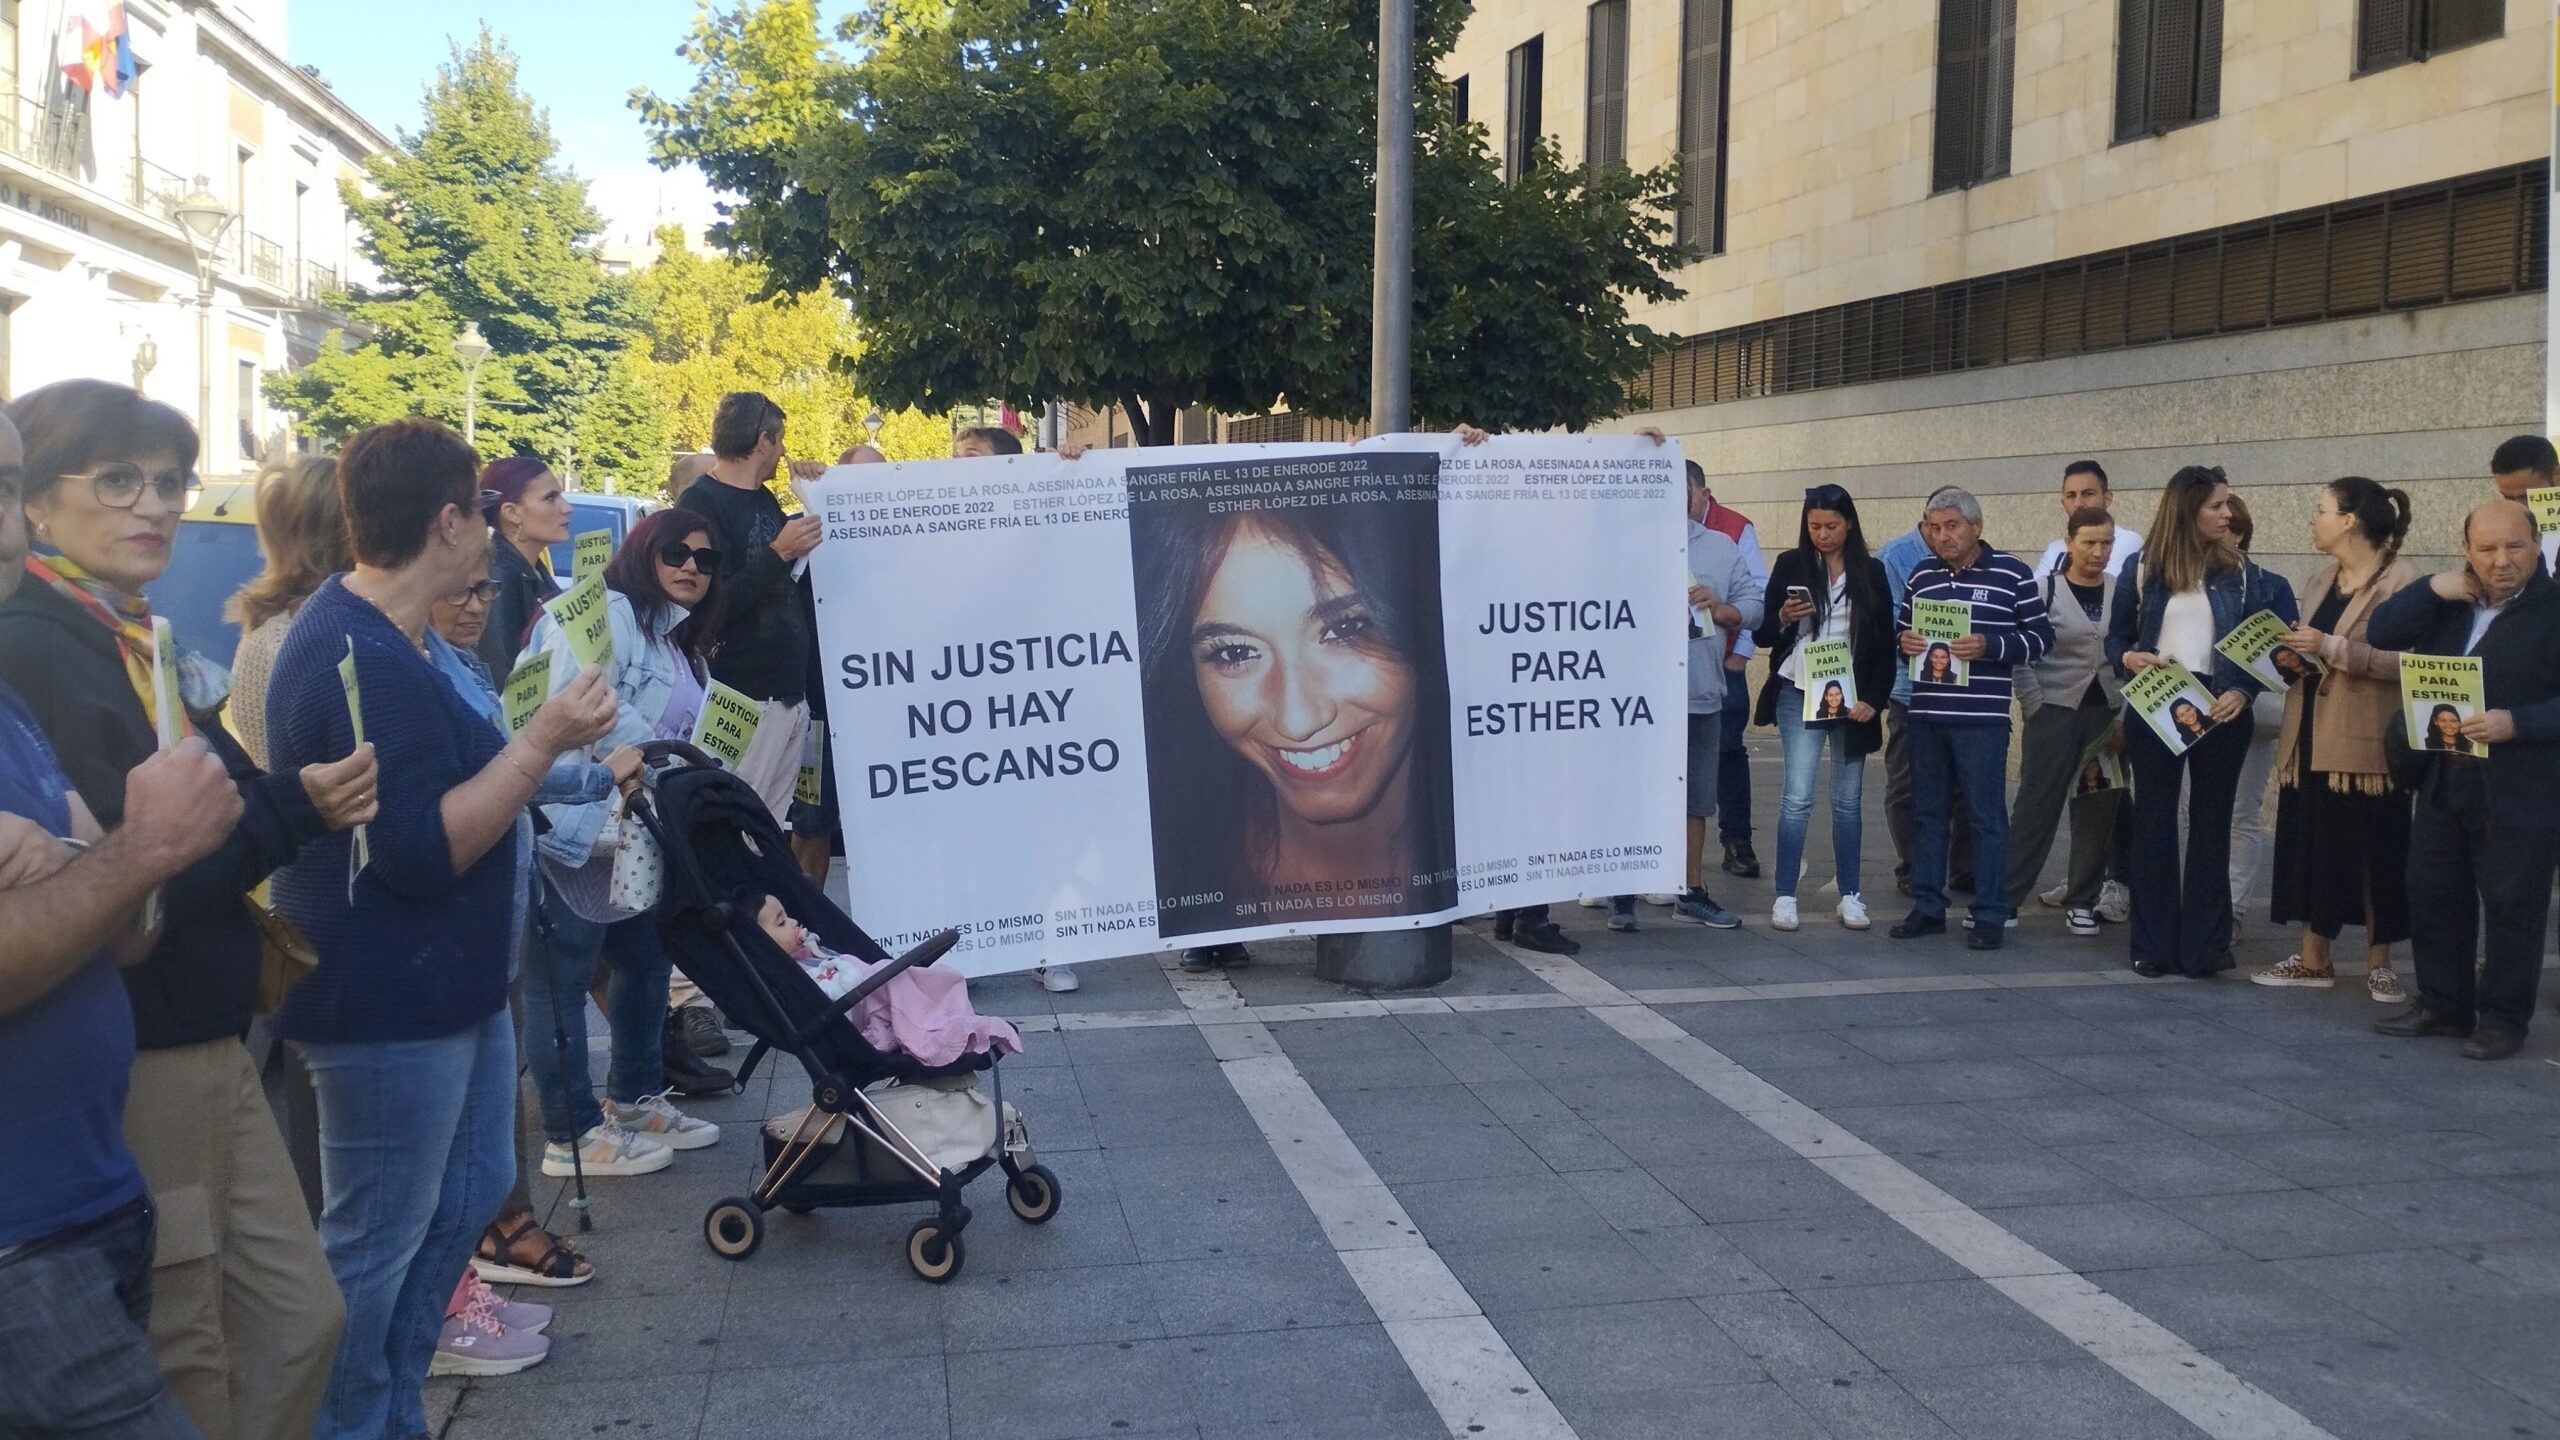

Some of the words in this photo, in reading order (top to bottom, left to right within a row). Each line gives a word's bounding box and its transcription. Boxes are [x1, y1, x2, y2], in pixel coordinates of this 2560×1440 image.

[39, 200, 88, 234] JUSTICIA
[1456, 460, 1470, 470] DE
[1475, 460, 1488, 470] LA
[1491, 460, 1526, 470] ROSA,
[1528, 460, 1590, 470] ASESINADA
[1593, 460, 1600, 469] A
[1602, 460, 1646, 470] SANGRE
[1649, 457, 1673, 470] FRÍA
[826, 492, 883, 506] ESTHER
[888, 486, 934, 502] LÓPEZ
[938, 486, 957, 499] DE
[961, 485, 977, 497] LA
[982, 483, 1024, 497] ROSA,
[1027, 478, 1104, 493] ASESINADA
[1107, 476, 1117, 487] A
[1120, 473, 1176, 487] SANGRE
[1181, 467, 1211, 482] FRÍA
[1214, 469, 1231, 481] EL
[1234, 468, 1248, 479] 13
[1252, 466, 1269, 478] DE
[1273, 462, 1337, 476] ENERODE
[1339, 460, 1368, 472] 2022
[1525, 474, 1568, 484] ESTHER
[1571, 472, 1605, 484] LÓPEZ
[1608, 474, 1623, 484] DE
[1626, 474, 1639, 484] LA
[1642, 474, 1672, 485] ROSA,
[1013, 498, 1065, 510] ESTHER
[1069, 491, 1113, 506] LÓPEZ
[1118, 492, 1136, 504] DE
[1140, 490, 1158, 502] LA
[1160, 488, 1202, 501] ROSA,
[1206, 482, 1282, 498] ASESINADA
[1284, 481, 1294, 492] A
[1296, 476, 1350, 491] SANGRE
[1354, 472, 1383, 487] FRÍA
[1385, 474, 1399, 485] EL
[1402, 474, 1415, 485] 13
[1417, 474, 1430, 485] DE
[1486, 474, 1510, 484] 2022
[1208, 500, 1261, 514] ESTHER
[1264, 495, 1307, 509] LÓPEZ
[1310, 494, 1328, 506] DE
[1332, 493, 1348, 504] LA
[1351, 490, 1390, 503] ROSA,
[1396, 490, 1454, 500] ASESINADA
[1456, 490, 1463, 500] A
[1466, 490, 1510, 500] SANGRE
[1542, 490, 1555, 500] EL
[1559, 490, 1570, 500] 13
[1573, 490, 1587, 499] DE
[1643, 488, 1666, 498] 2022
[827, 511, 846, 523] EL
[850, 510, 865, 521] 13
[870, 508, 889, 520] DE
[893, 504, 961, 518] ENERODE
[964, 502, 994, 514] 2022
[829, 524, 912, 540] ASESINADA
[916, 524, 925, 534] A
[928, 518, 986, 534] SANGRE
[990, 514, 1022, 529] FRÍA
[1025, 515, 1041, 526] EL
[1044, 514, 1058, 524] 13
[1062, 512, 1080, 523] DE
[582, 556, 607, 566] PARA
[1479, 600, 1636, 634] JUSTICIA
[1914, 602, 1969, 616] #JUSTICIA
[1924, 616, 1954, 626] PARA
[2220, 612, 2274, 652] #JUSTICIA
[1918, 628, 1960, 640] ESTHER
[2241, 626, 2272, 651] PARA
[842, 650, 915, 690] SIN
[930, 630, 1133, 681] JUSTICIA
[1804, 642, 1848, 656] #JUSTICIA
[1512, 650, 1606, 683] PARA
[1816, 656, 1840, 666] PARA
[2401, 659, 2478, 672] #JUSTICIA
[1812, 667, 1847, 679] ESTHER
[2419, 675, 2459, 687] PARA
[516, 684, 538, 706] PARA
[2144, 674, 2173, 698] PARA
[2146, 680, 2188, 714] ESTHER
[2412, 690, 2470, 702] ESTHER
[710, 691, 760, 728] #JUSTICIA
[908, 700, 972, 738] NO
[988, 688, 1074, 730] HAY
[1467, 698, 1601, 736] ESTHER
[1610, 696, 1654, 726] YA
[716, 717, 742, 740] PARA
[703, 732, 740, 760] ESTHER
[868, 738, 1119, 799] DESCANSO
[1528, 855, 1545, 866] SIN
[1548, 854, 1557, 864] TI
[1560, 851, 1588, 862] NADA
[1590, 849, 1604, 859] ES
[1606, 848, 1620, 858] LO
[1624, 845, 1662, 856] MISMO
[1413, 874, 1432, 886] SIN
[1461, 866, 1472, 876] ES
[1473, 863, 1484, 874] LO
[1487, 858, 1518, 871] MISMO
[1526, 870, 1542, 881] SIN
[1545, 868, 1554, 878] TI
[1556, 866, 1584, 877] NADA
[1587, 864, 1600, 874] ES
[1604, 862, 1618, 872] LO
[1620, 860, 1659, 871] MISMO
[1274, 882, 1312, 895] NADA
[1316, 881, 1332, 892] ES
[1337, 879, 1354, 891] LO
[1358, 876, 1401, 890] MISMO
[1462, 880, 1472, 892] ES
[1474, 878, 1486, 889] LO
[1488, 873, 1518, 887] MISMO
[1054, 910, 1076, 922] SIN
[1080, 907, 1092, 919] TI
[1096, 903, 1135, 918] NADA
[1138, 900, 1155, 912] ES
[1159, 898, 1177, 910] LO
[1180, 892, 1224, 907] MISMO
[1236, 904, 1256, 916] SIN
[1260, 901, 1272, 912] TI
[1276, 898, 1314, 911] NADA
[1316, 896, 1333, 908] ES
[1338, 895, 1354, 908] LO
[1358, 892, 1403, 906] MISMO
[896, 933, 908, 945] TI
[954, 924, 972, 935] ES
[976, 920, 994, 933] LO
[998, 914, 1044, 929] MISMO
[1056, 926, 1078, 938] SIN
[1082, 923, 1094, 935] TI
[1098, 918, 1136, 932] NADA
[1139, 916, 1156, 928] ES
[956, 940, 974, 952] ES
[978, 936, 996, 949] LO
[1000, 930, 1045, 946] MISMO
